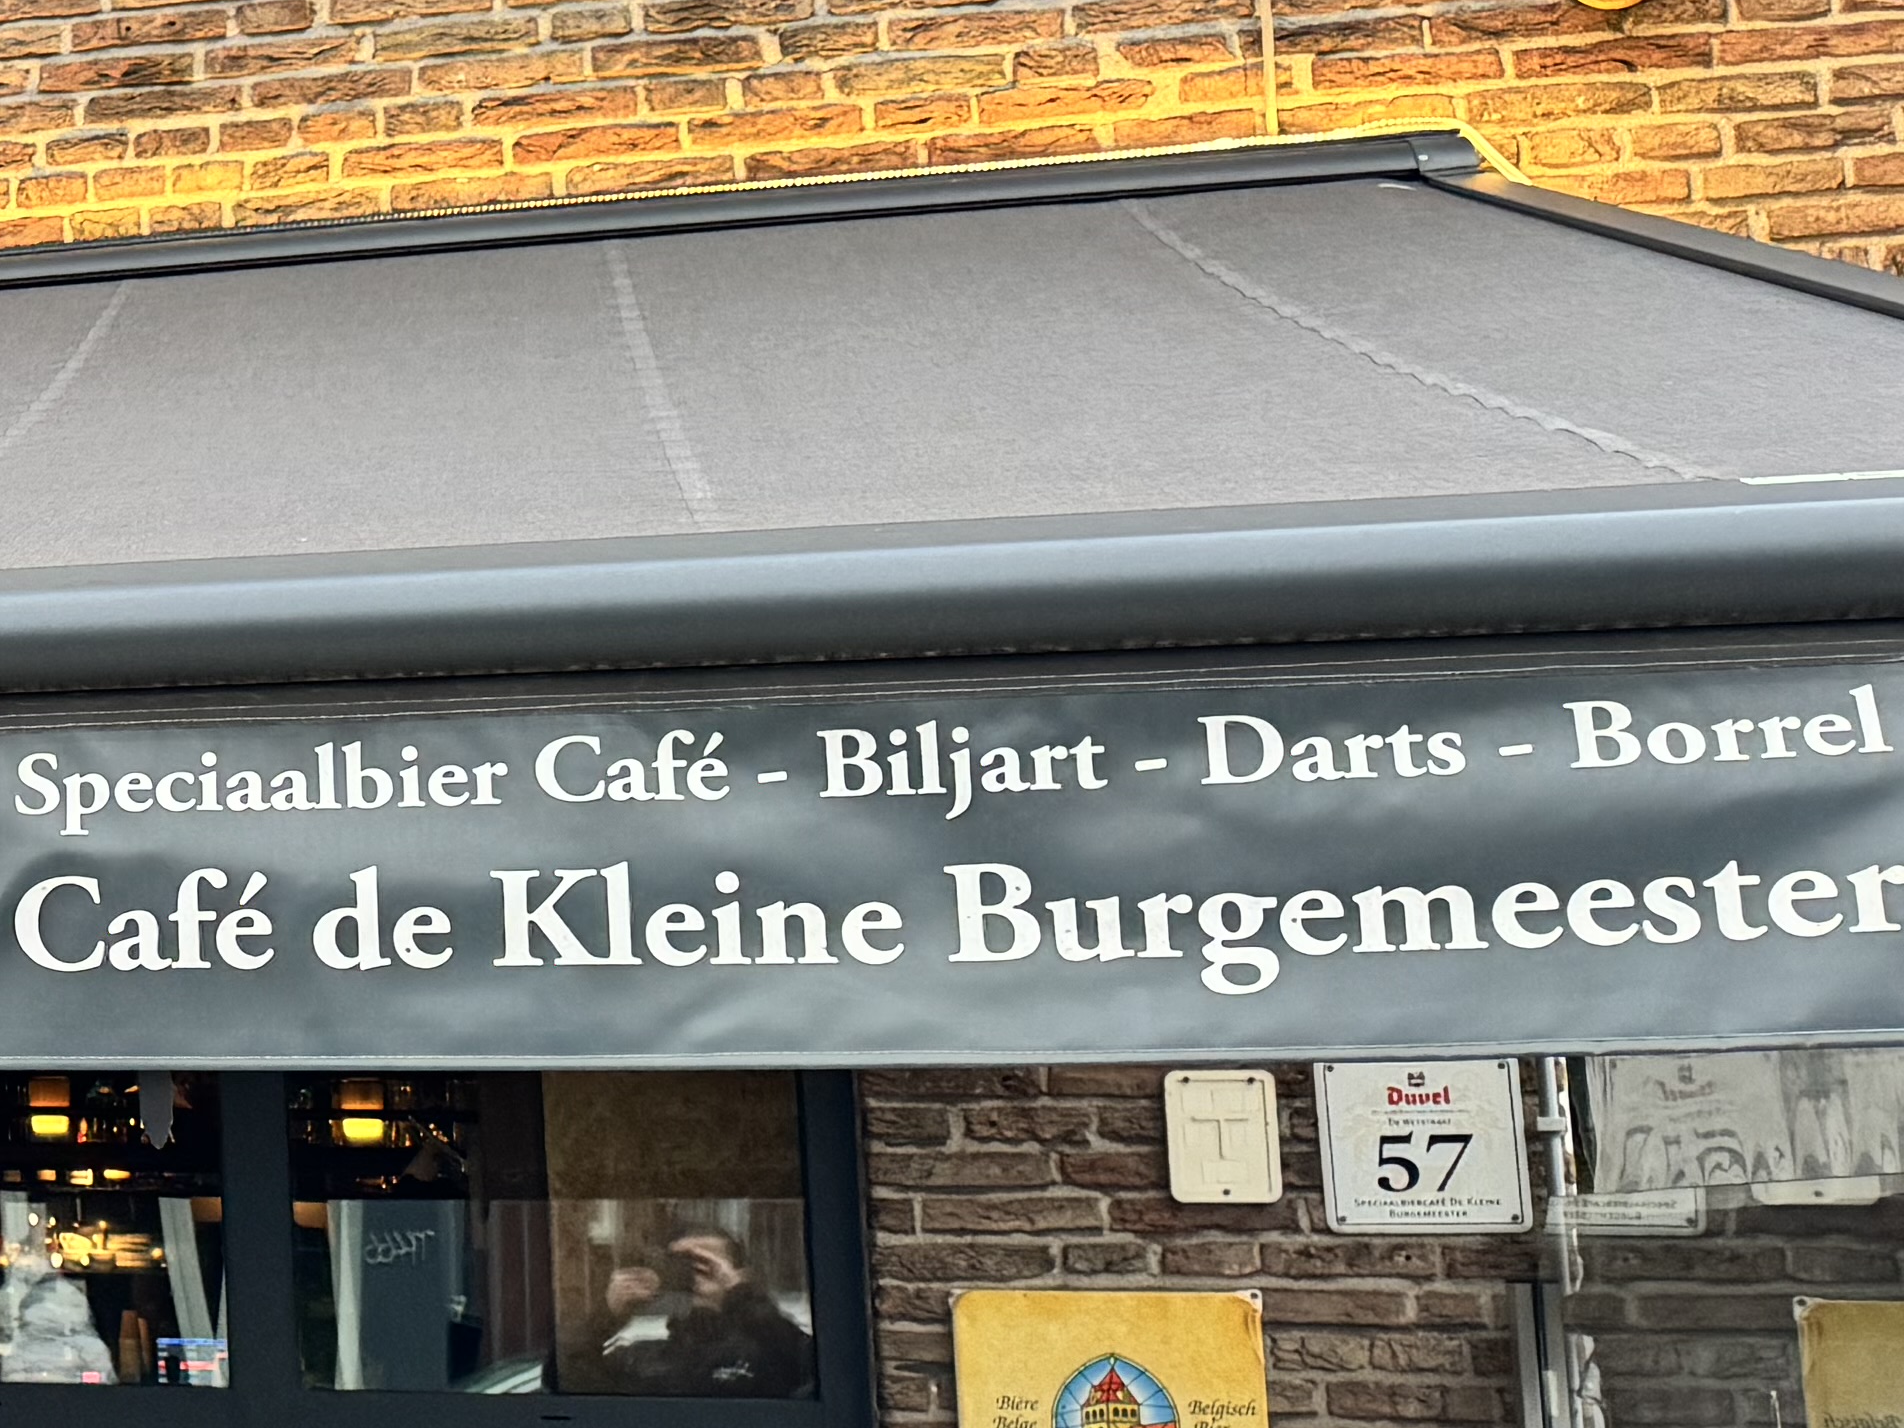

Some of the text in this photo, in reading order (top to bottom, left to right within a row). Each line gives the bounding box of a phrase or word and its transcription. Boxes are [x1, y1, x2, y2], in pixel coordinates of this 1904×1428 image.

[14, 740, 508, 836] Speciaalbier
[535, 729, 730, 802] Café
[816, 720, 1108, 820] Biljart
[1197, 715, 1466, 785] Darts
[1562, 683, 1894, 769] Borrel
[14, 860, 1904, 995] Café de Kleine Burgemeester
[1386, 1085, 1451, 1106] Duvel
[1377, 1130, 1474, 1193] 57
[1188, 1399, 1257, 1423] Belgisch
